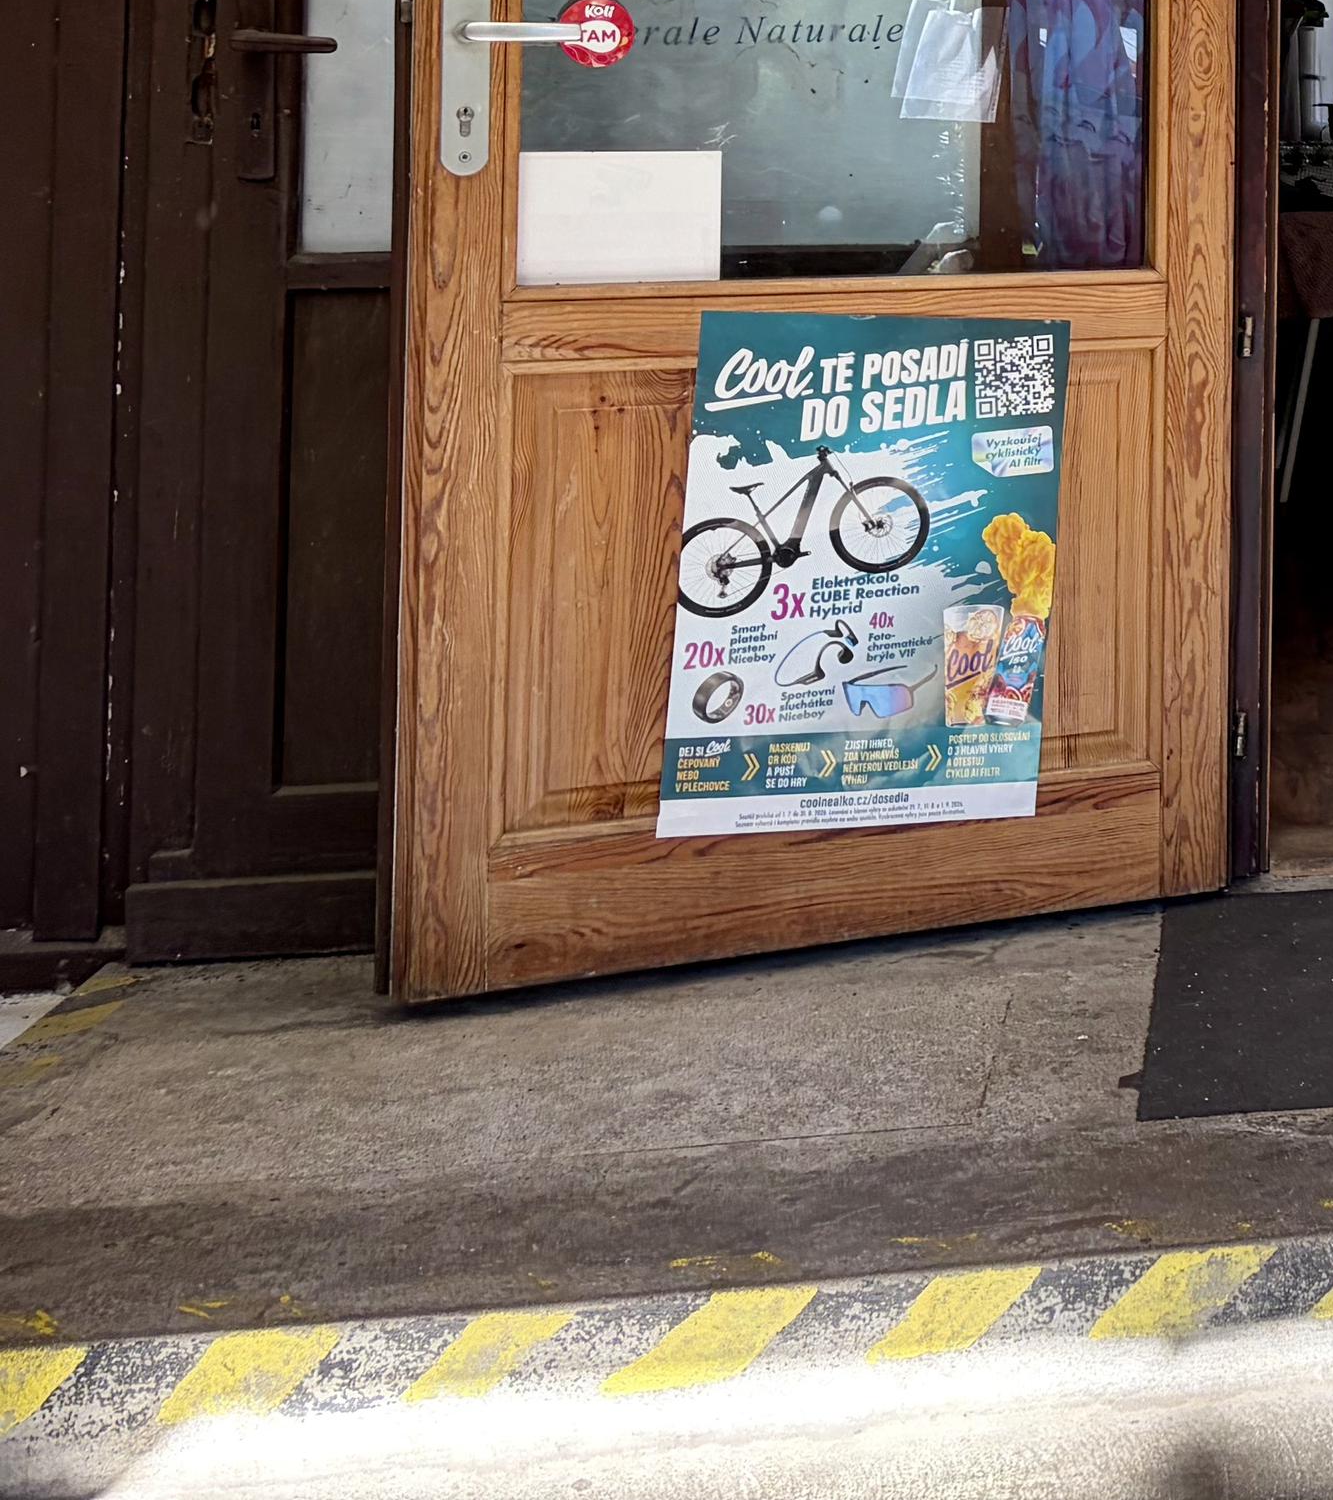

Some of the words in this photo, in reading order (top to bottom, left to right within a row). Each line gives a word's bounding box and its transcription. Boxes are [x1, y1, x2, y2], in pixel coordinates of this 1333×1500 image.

[735, 14, 904, 45] Naturale
[714, 346, 814, 399] Cool
[821, 351, 855, 394] TĚ
[862, 339, 969, 389] POSADÍ
[800, 398, 849, 441] DO
[860, 380, 966, 432] SEDLA
[986, 433, 1042, 449] Vyzkoušej
[985, 446, 1041, 460] cyklistický
[1024, 457, 1042, 466] filtr
[812, 573, 900, 590] Elektrokolo
[771, 583, 806, 621] 3x
[810, 590, 850, 603] CUBE
[856, 584, 920, 600] Reaction
[810, 601, 862, 619] Hybrid
[731, 623, 766, 634] Smart
[869, 612, 895, 629] 40x
[730, 631, 778, 646] platební
[867, 637, 933, 651] chromatické
[683, 641, 726, 670] 20x
[728, 653, 776, 665] Niceboy
[947, 639, 993, 681] Cool
[781, 686, 835, 701] Sportovní
[779, 698, 833, 712] sluchátka
[744, 703, 775, 725] 30x
[779, 709, 826, 724] Niceboy
[679, 746, 693, 758] DEJ
[800, 792, 909, 809] coolnealko.cz/dosedla
